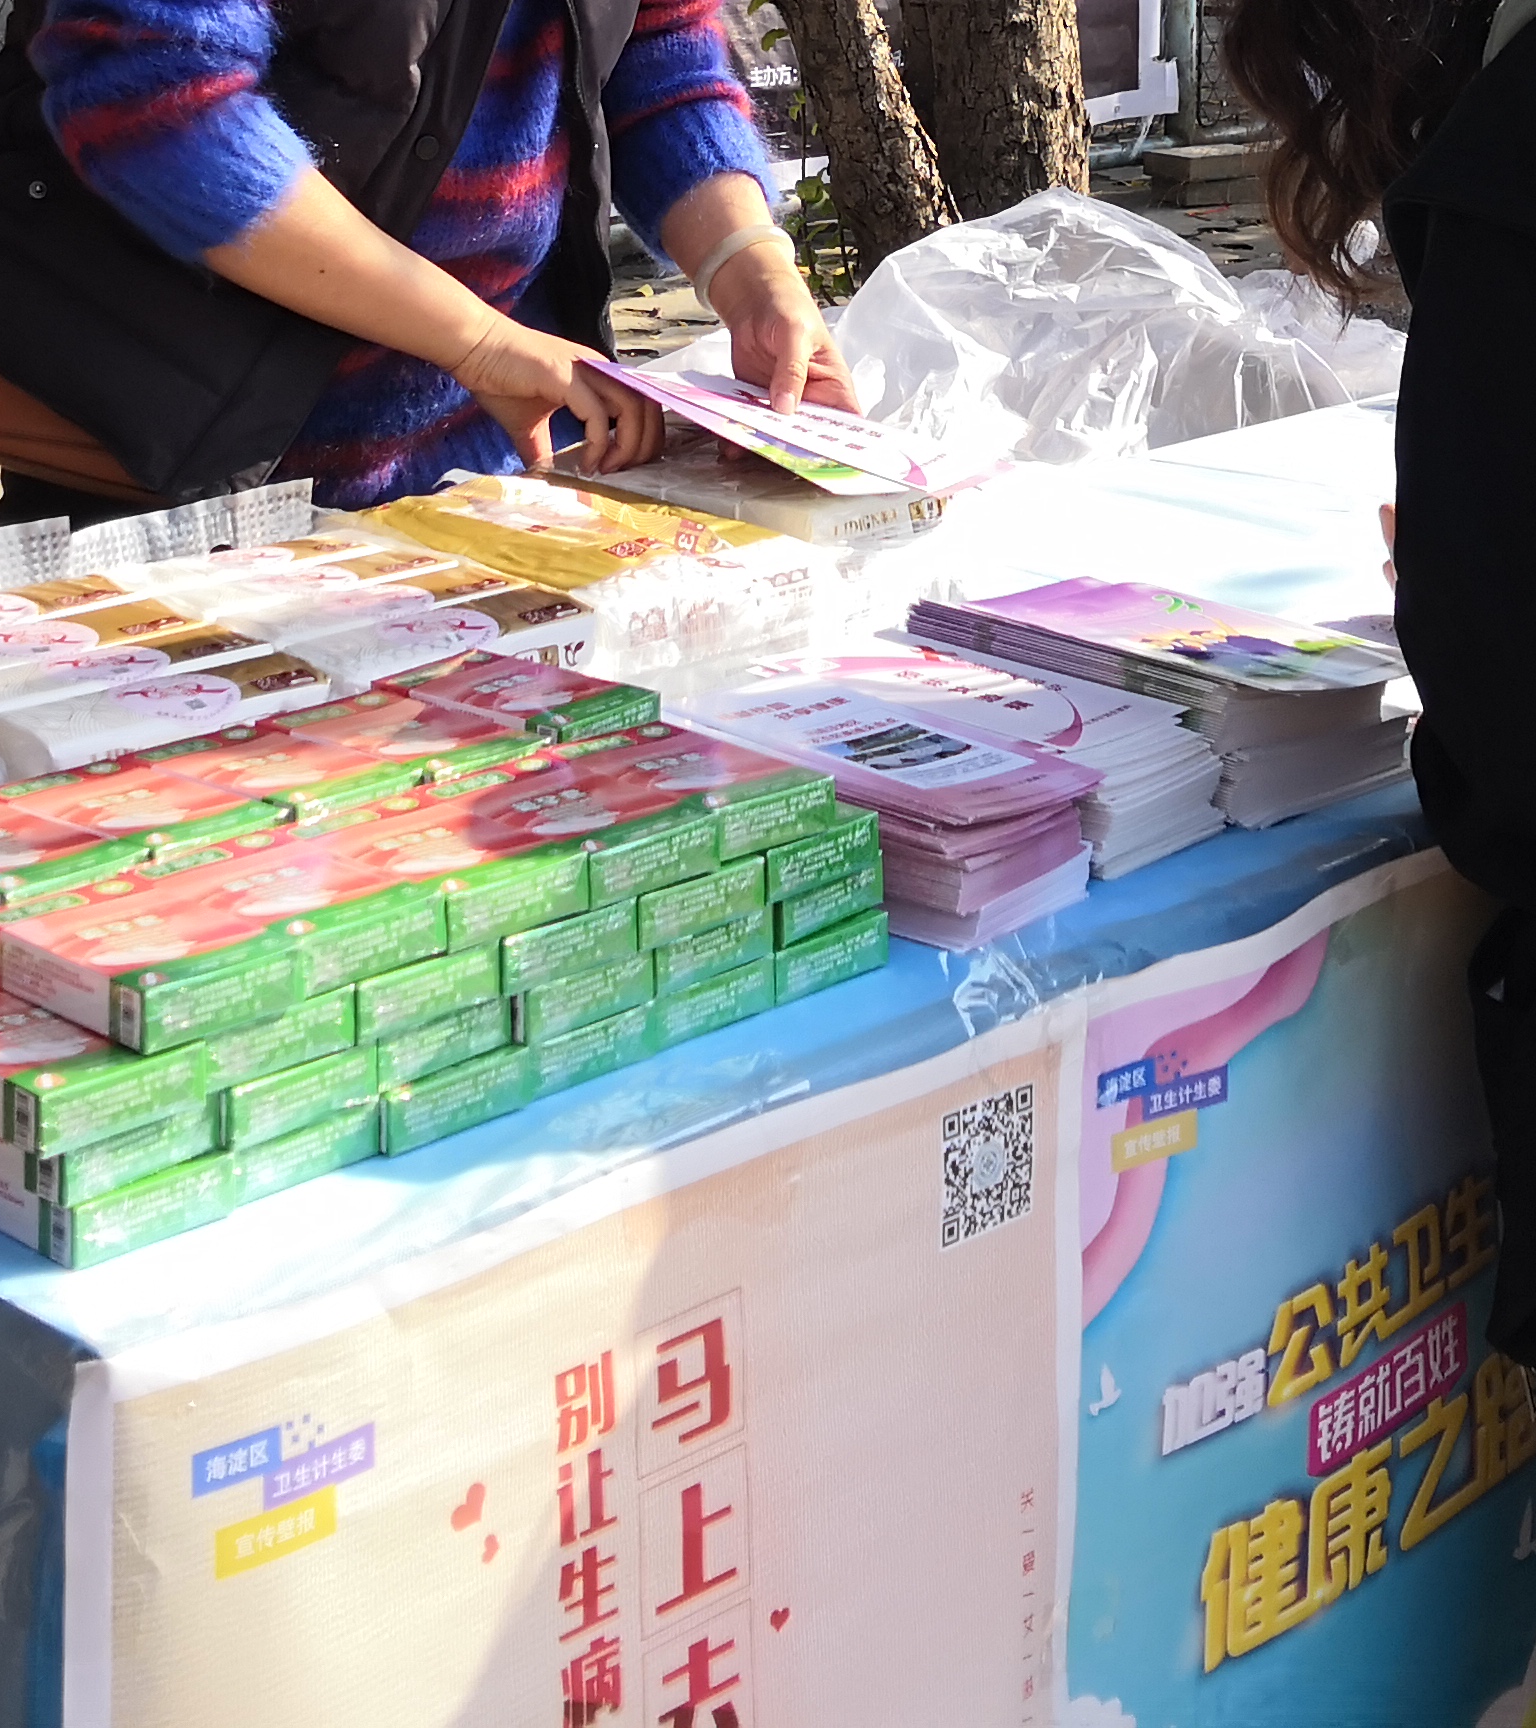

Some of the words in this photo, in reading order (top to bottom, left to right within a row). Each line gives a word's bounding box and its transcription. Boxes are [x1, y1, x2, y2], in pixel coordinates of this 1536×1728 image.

[1149, 1075, 1222, 1114] 卫生计生委
[1162, 1348, 1265, 1456] 加强
[1267, 1174, 1499, 1407] 公共卫生
[1317, 1315, 1461, 1464] 铸就百姓
[205, 1438, 270, 1483] 海淀区
[272, 1436, 366, 1499] 卫生计生委
[235, 1507, 315, 1560] 宣传壁报
[555, 1349, 621, 1728] 别让生病
